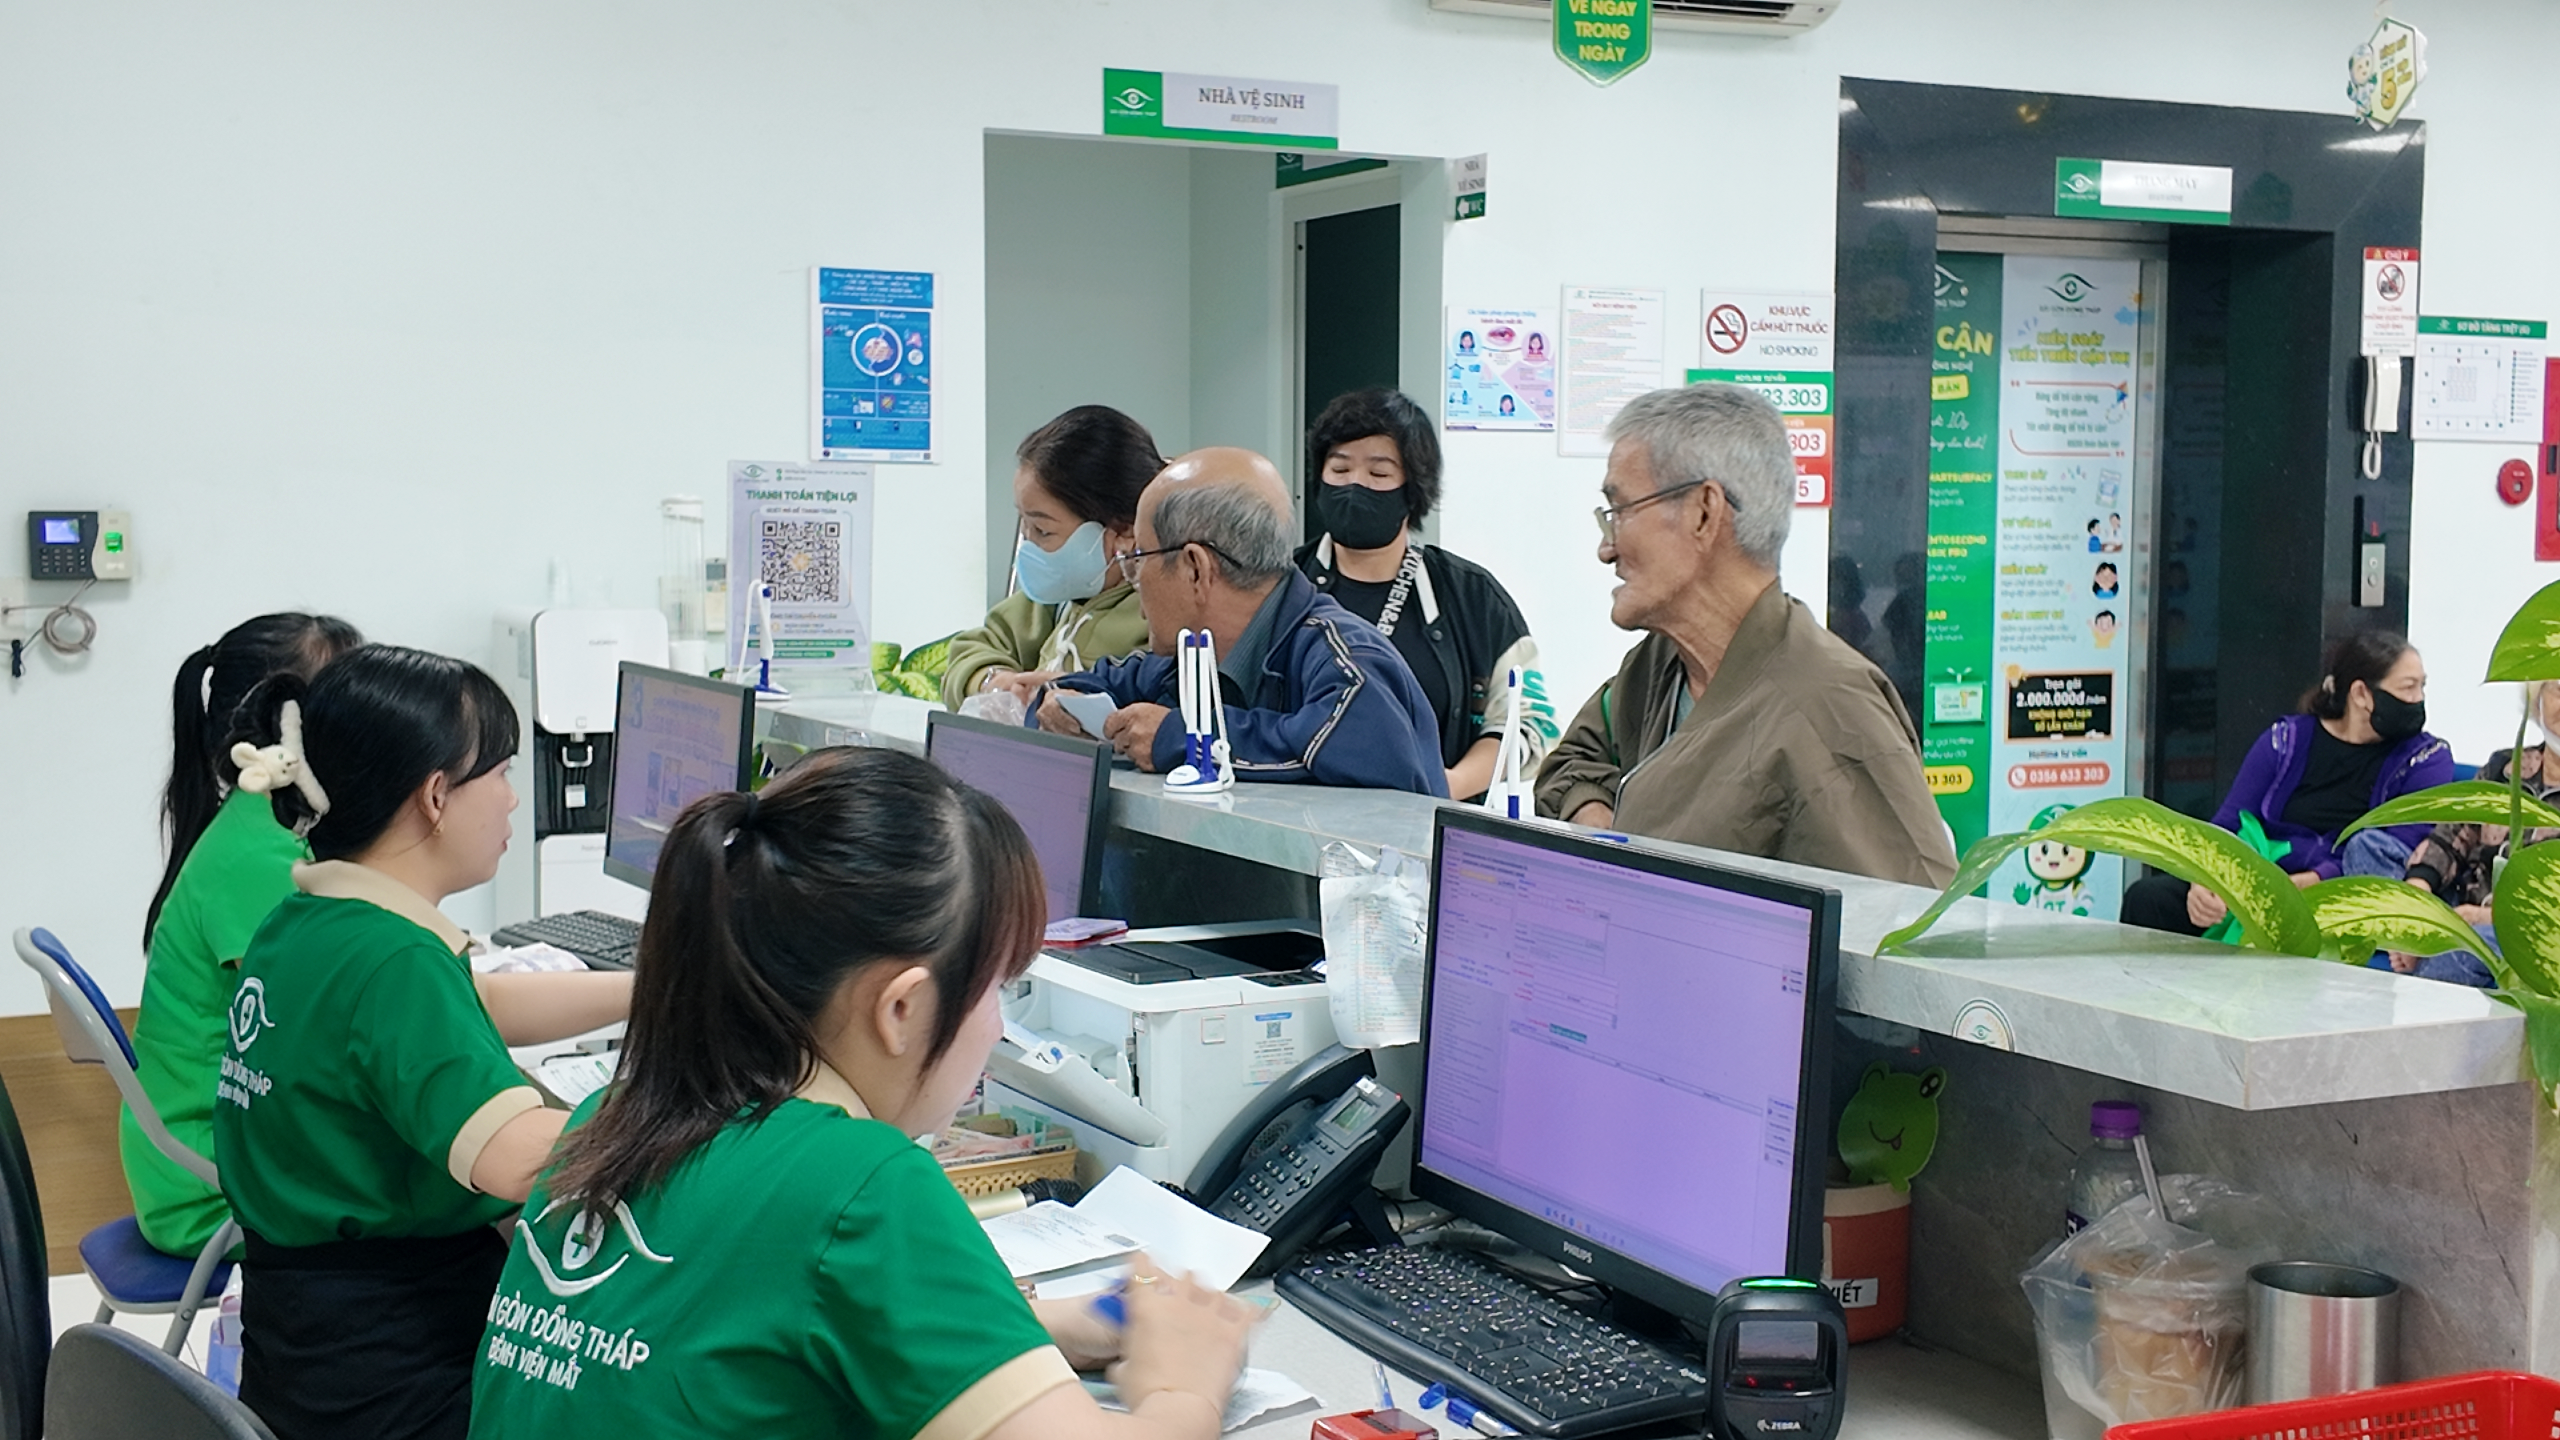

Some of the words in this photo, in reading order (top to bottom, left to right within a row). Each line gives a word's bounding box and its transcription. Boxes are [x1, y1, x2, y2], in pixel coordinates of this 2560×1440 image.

[1592, 0, 1637, 17] NGAY
[1574, 21, 1631, 40] TRONG
[1579, 42, 1627, 62] NGÀY
[1198, 86, 1236, 105] NHÀ
[1239, 87, 1261, 110] VỆ
[1263, 93, 1305, 109] SINH
[1795, 320, 1828, 334] THUỐC
[1936, 321, 1994, 359] CẬN
[1759, 345, 1774, 356] NO
[1775, 345, 1818, 358] SMOKING
[746, 489, 782, 501] THANH
[785, 488, 814, 501] TOÁN
[816, 489, 838, 503] TIỆN
[840, 490, 858, 503] LỢI
[2029, 769, 2058, 783] 0356
[2060, 767, 2081, 782] 633
[2083, 766, 2105, 781] 303
[1563, 1241, 1592, 1264] PHILIPS
[1831, 1279, 1862, 1303] IẾT
[496, 1290, 534, 1333] GÒN
[530, 1304, 585, 1351] ĐỒNG
[584, 1325, 650, 1371] THÁP
[488, 1332, 518, 1369] BỆNH
[517, 1345, 549, 1382] VIỆN
[546, 1353, 583, 1391] MẮT
[1771, 1421, 1801, 1430] ZEBRA
